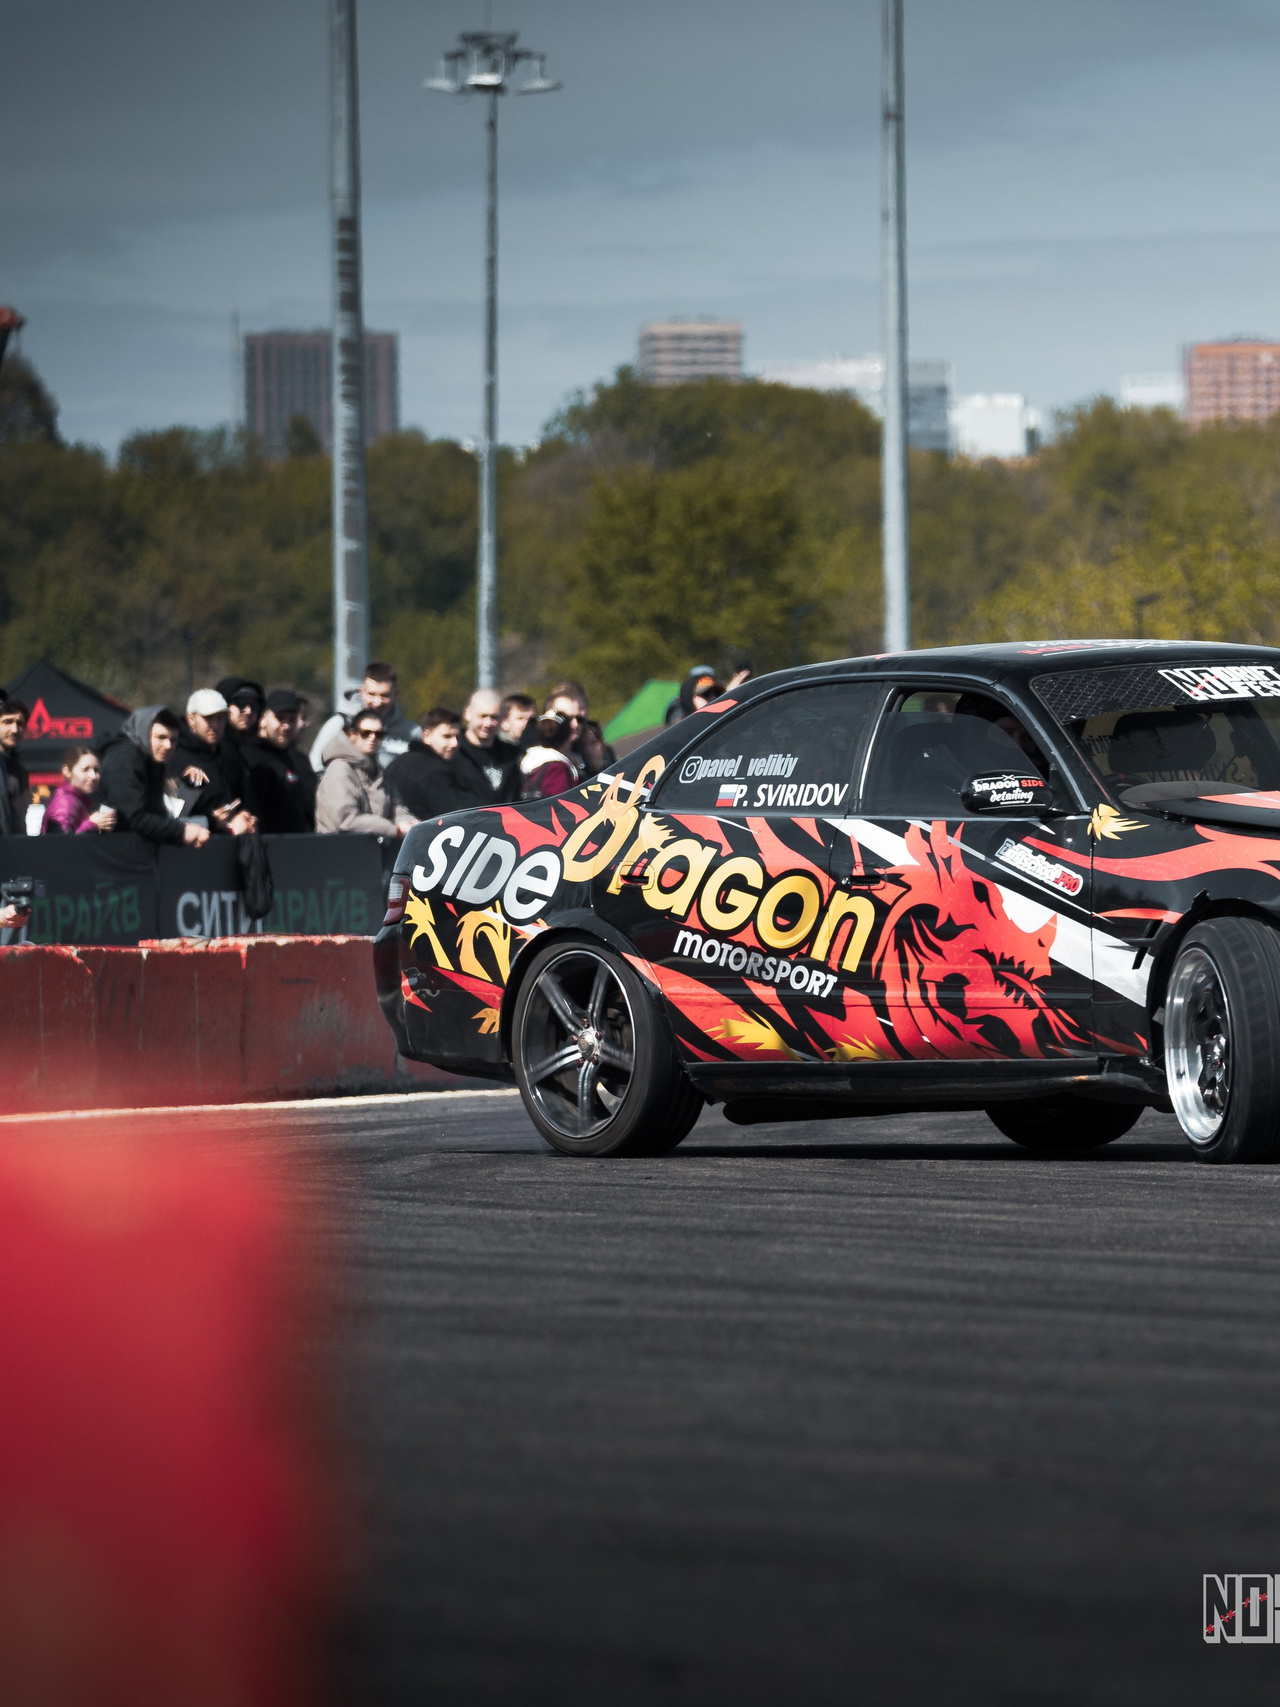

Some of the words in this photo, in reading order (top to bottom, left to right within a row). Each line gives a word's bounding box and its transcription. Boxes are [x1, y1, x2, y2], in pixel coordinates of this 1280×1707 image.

[698, 754, 799, 780] pavel_velikiy
[732, 784, 749, 807] P.
[753, 783, 849, 807] SVIRIDOV
[972, 780, 1020, 792] DRAGON
[1021, 779, 1044, 787] SIDE
[990, 788, 1034, 803] detailing
